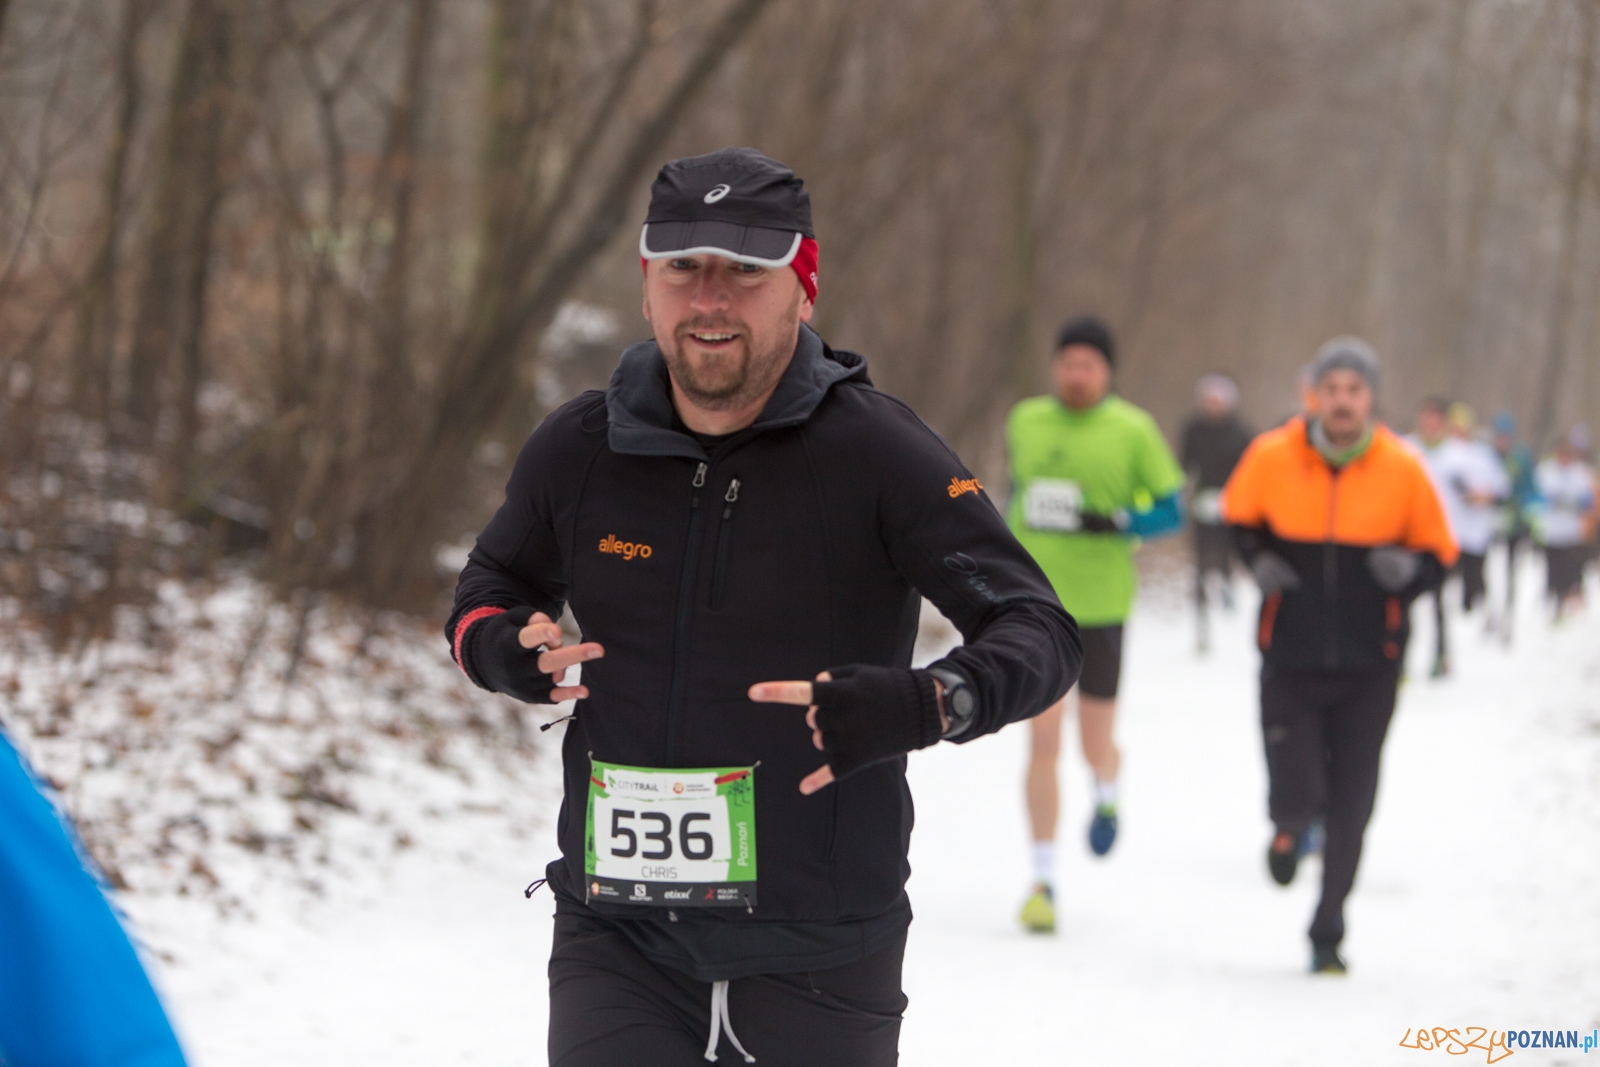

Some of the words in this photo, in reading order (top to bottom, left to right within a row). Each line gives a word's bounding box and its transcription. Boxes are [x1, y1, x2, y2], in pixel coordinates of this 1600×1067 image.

[598, 533, 653, 561] allegro
[610, 808, 714, 861] 536
[641, 865, 678, 880] CHRIS
